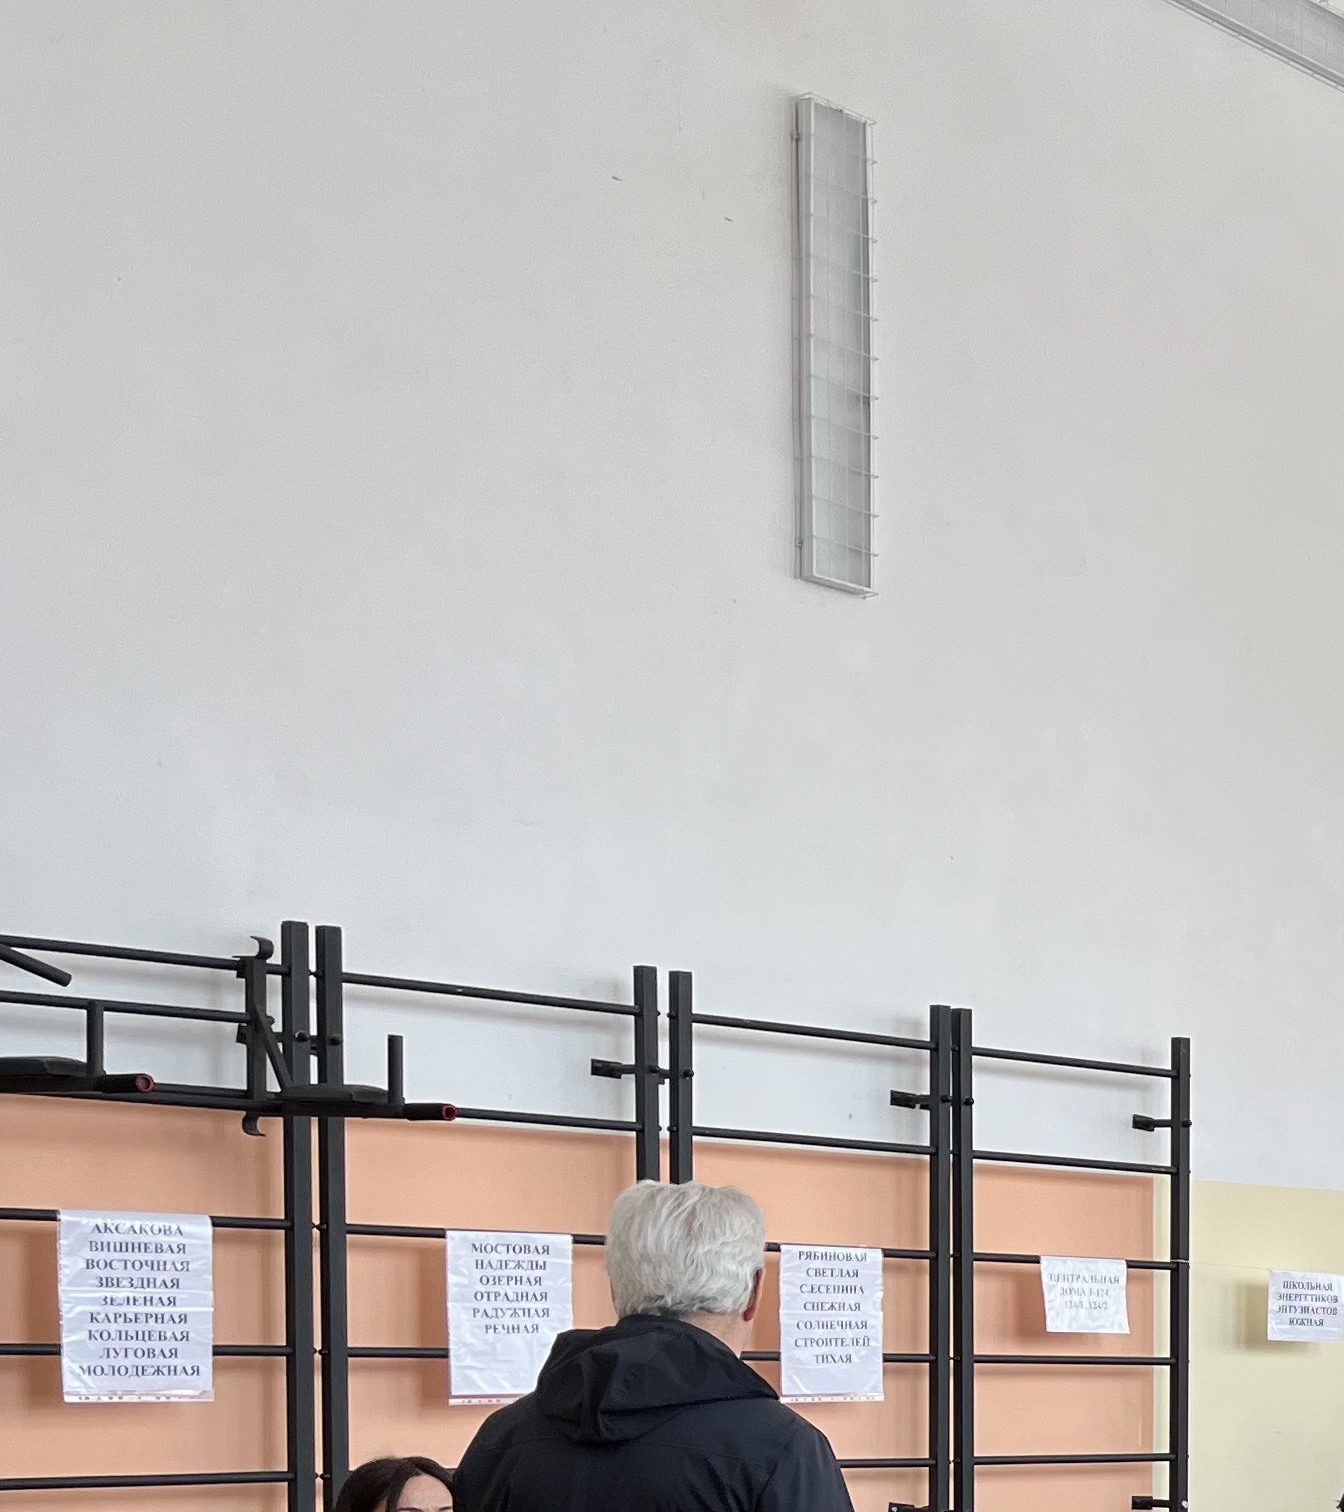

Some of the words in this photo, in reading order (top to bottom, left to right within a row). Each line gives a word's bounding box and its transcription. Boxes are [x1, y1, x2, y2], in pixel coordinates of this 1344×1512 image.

[91, 1222, 184, 1237] АКСАКОВА
[89, 1240, 187, 1255] ВИШНЕВАЯ
[471, 1243, 550, 1255] МОСТОВАЯ
[798, 1250, 868, 1262] РЯБИНОВАЯ
[85, 1258, 190, 1272] ВОСТОЧНАЯ
[475, 1259, 547, 1271] НАДЕЖДЫ
[806, 1267, 859, 1278] СВЕТЛАЯ
[95, 1276, 181, 1290] ЗВЕЗДНАЯ
[479, 1274, 542, 1286] ОЗЕРНАЯ
[1049, 1273, 1120, 1285] ЦЕНТРАЛЬНАЯ
[799, 1283, 865, 1295] С.ЕСЕНИНА
[1060, 1286, 1087, 1297] ДОМА
[1282, 1280, 1333, 1292] ШКОЛЬНАЯ
[99, 1295, 177, 1307] ЗЕЛЕНАЯ
[474, 1291, 548, 1303] ОТРАДНАЯ
[1276, 1292, 1339, 1304] ЭНЕРГЕТИКОВ
[803, 1301, 861, 1312] СНЕЖНАЯ
[1276, 1304, 1338, 1316] ЭНТУЗИАСТОВ
[89, 1311, 188, 1325] КАРЬЕРНАЯ
[472, 1307, 550, 1319] РАДУЖНАЯ
[796, 1320, 868, 1330] СОЛНЕЧНАЯ
[1288, 1317, 1325, 1327] ЮЖНАЯ
[485, 1323, 540, 1335] РЕЧНАЯ
[87, 1329, 190, 1343] КОЛЬЦЕВАЯ
[794, 1335, 871, 1348] СТРОИТЕЛЕЙ
[99, 1347, 179, 1360] ЛУГОВАЯ
[814, 1353, 853, 1364] ТИХАЯ
[78, 1364, 201, 1378] МОЛОДЕЖНАЯ
